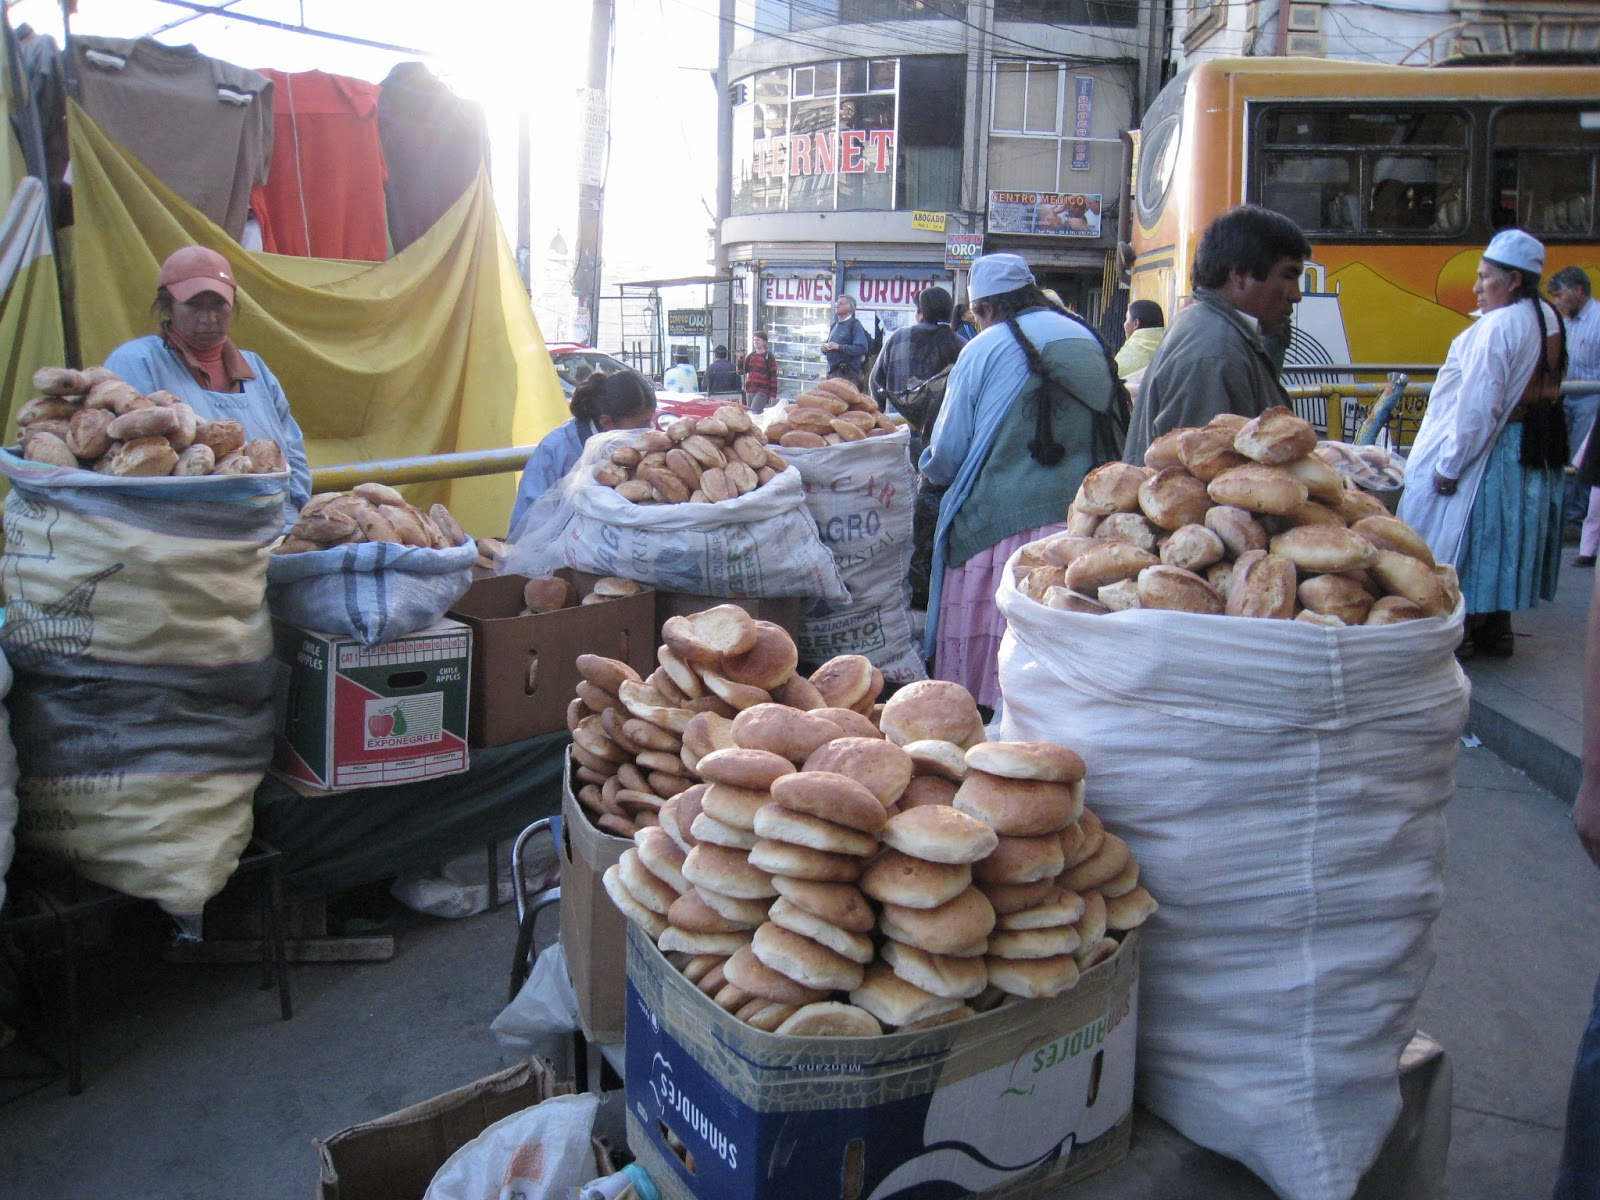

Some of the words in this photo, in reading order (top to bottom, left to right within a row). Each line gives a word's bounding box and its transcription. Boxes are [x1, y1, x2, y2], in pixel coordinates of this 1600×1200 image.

[991, 192, 1036, 204] CENTRO
[913, 213, 945, 223] ABOGADO
[951, 243, 976, 256] ORO
[775, 280, 832, 301] LLAVES
[367, 733, 441, 748] EXPONEGRETE
